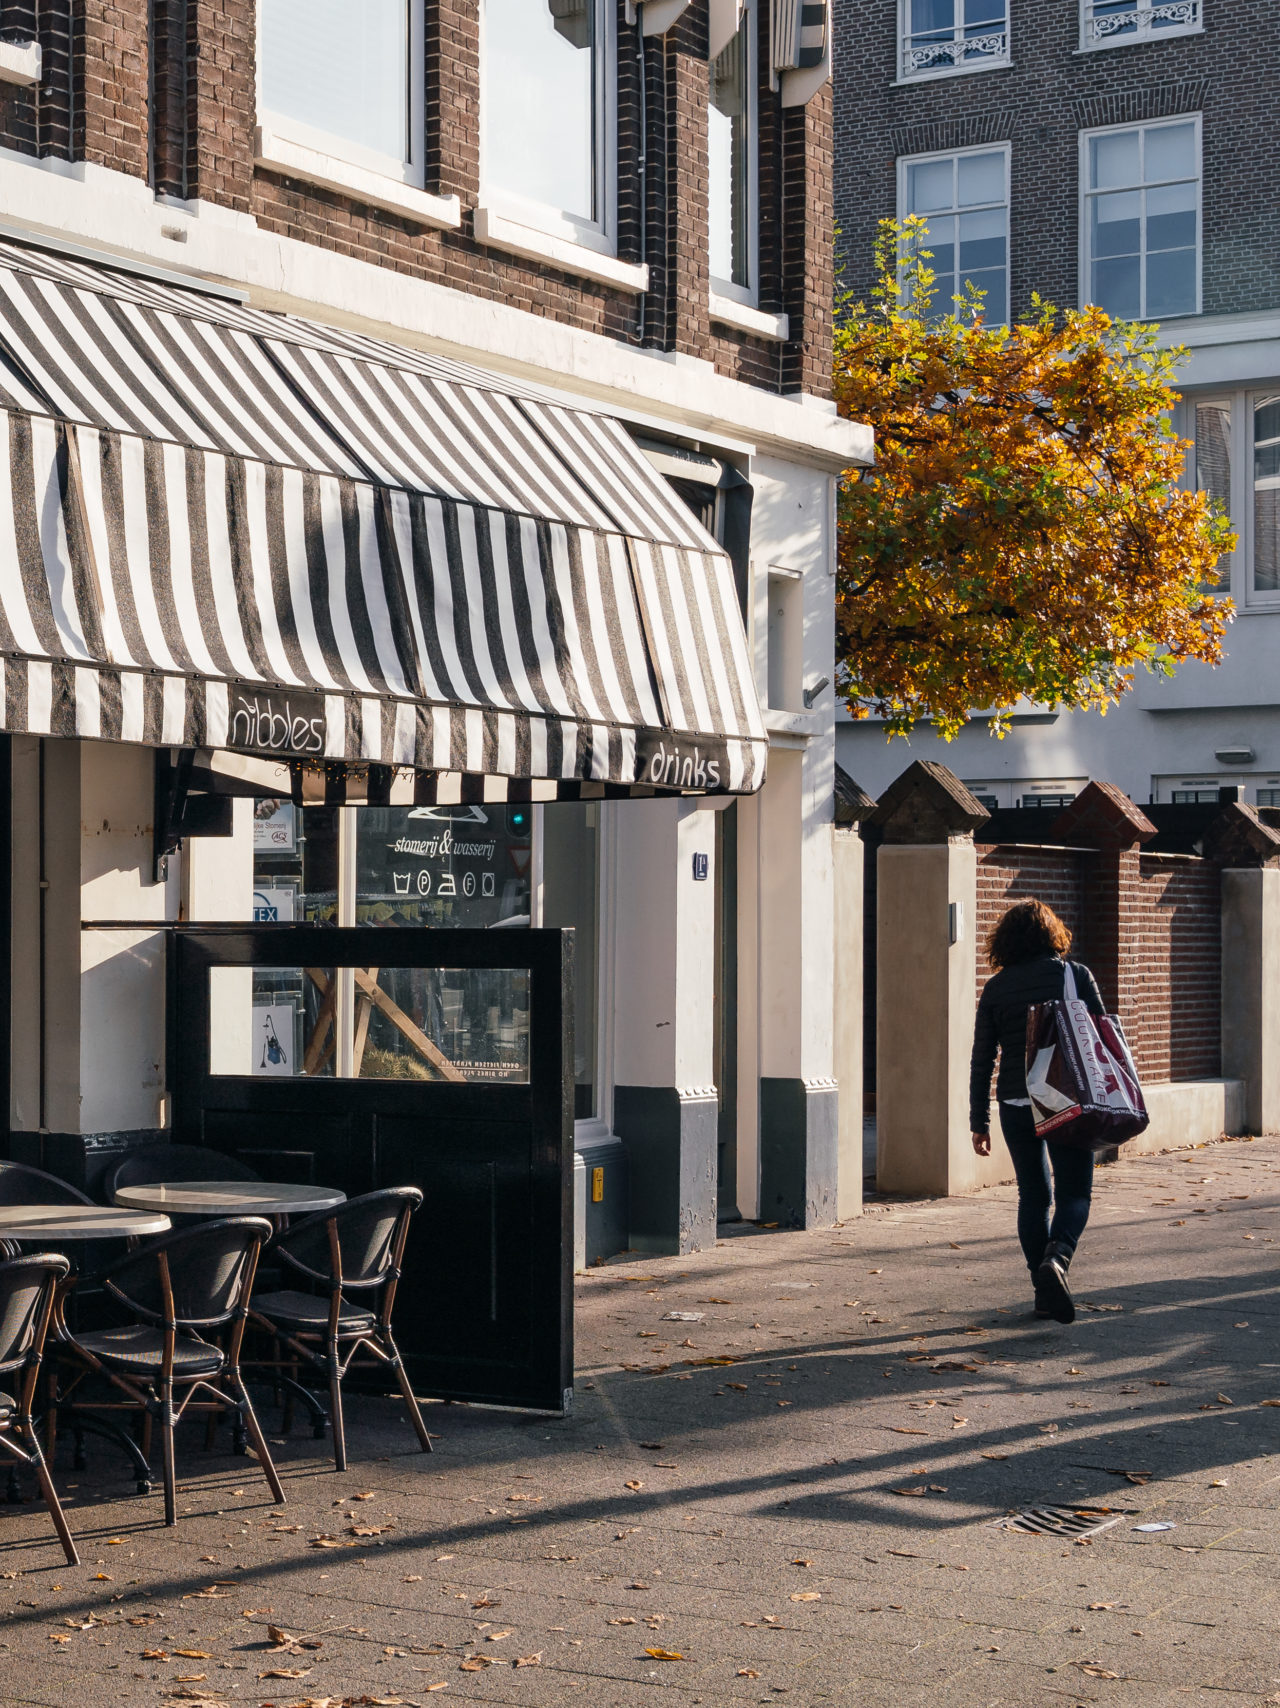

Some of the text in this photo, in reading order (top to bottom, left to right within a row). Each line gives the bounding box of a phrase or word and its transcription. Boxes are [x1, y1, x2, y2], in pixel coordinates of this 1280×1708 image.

[232, 696, 324, 753] nibbles
[650, 741, 721, 789] drinks
[394, 829, 497, 861] stomerij & wasserij
